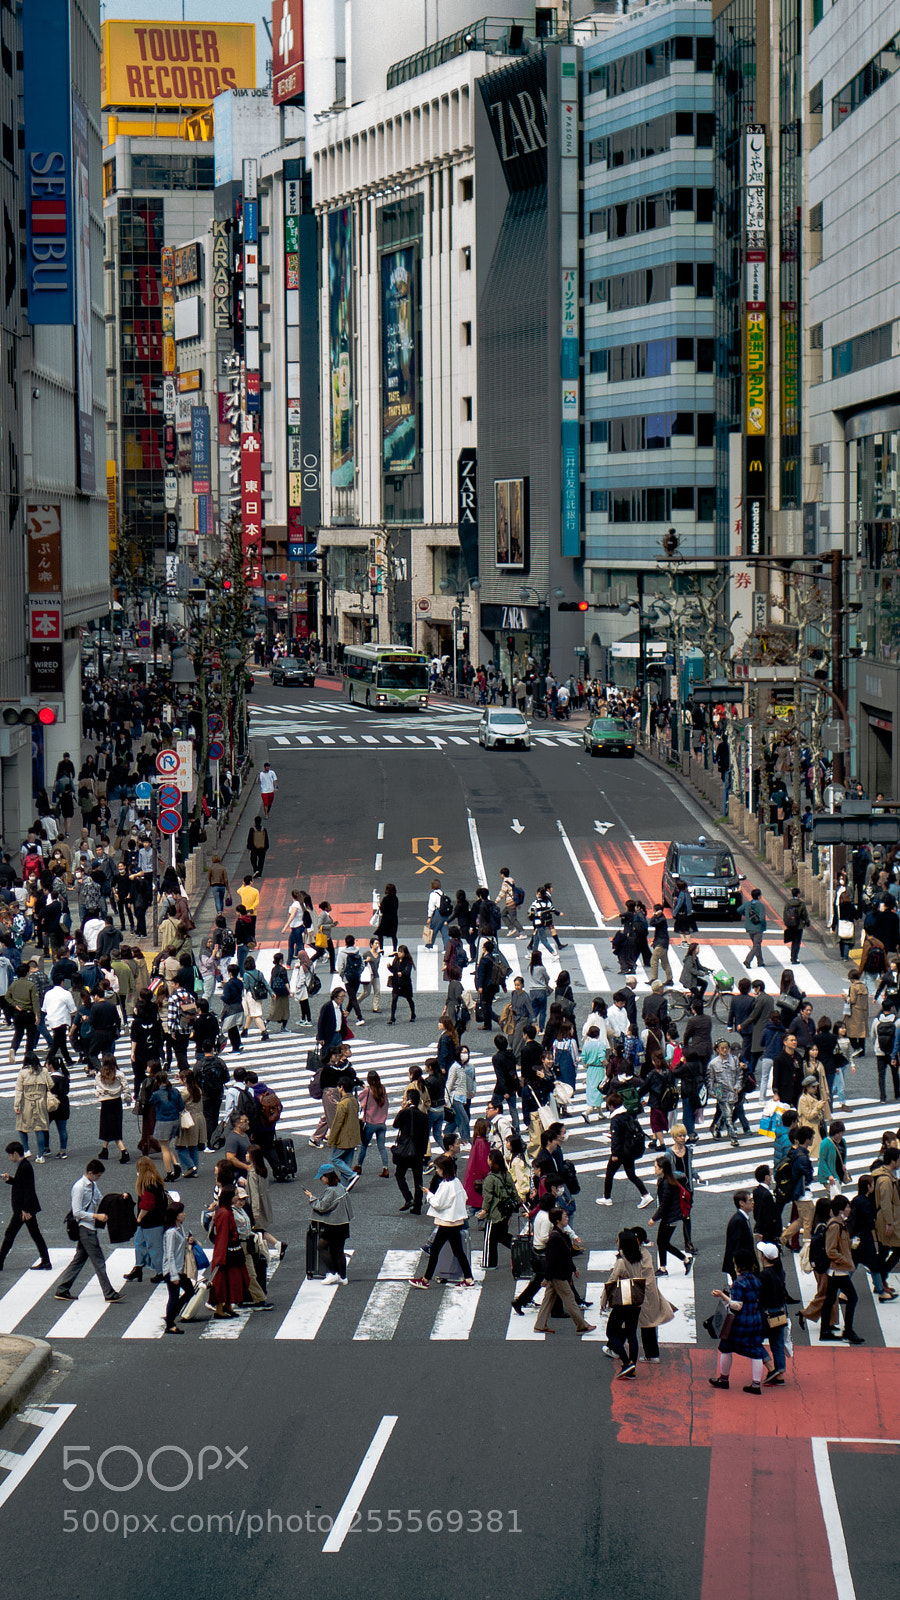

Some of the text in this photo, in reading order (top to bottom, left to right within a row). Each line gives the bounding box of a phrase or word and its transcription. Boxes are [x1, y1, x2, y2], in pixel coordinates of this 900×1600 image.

[134, 28, 220, 63] TOWER
[126, 65, 236, 99] RECORDS
[251, 88, 269, 98] JOE
[30, 151, 68, 291] SEIBU
[213, 221, 230, 328] KARAOKE
[564, 271, 575, 321] パーソナル
[748, 323, 764, 407] 八重洲コンタクト
[460, 460, 476, 523] ZARA
[565, 447, 577, 530] 三井住友信託銀行
[752, 501, 760, 554] McDonald's
[35, 613, 56, 636] 本
[121, 630, 131, 640] P
[502, 606, 526, 629] ZARA
[34, 661, 59, 669] WIRED
